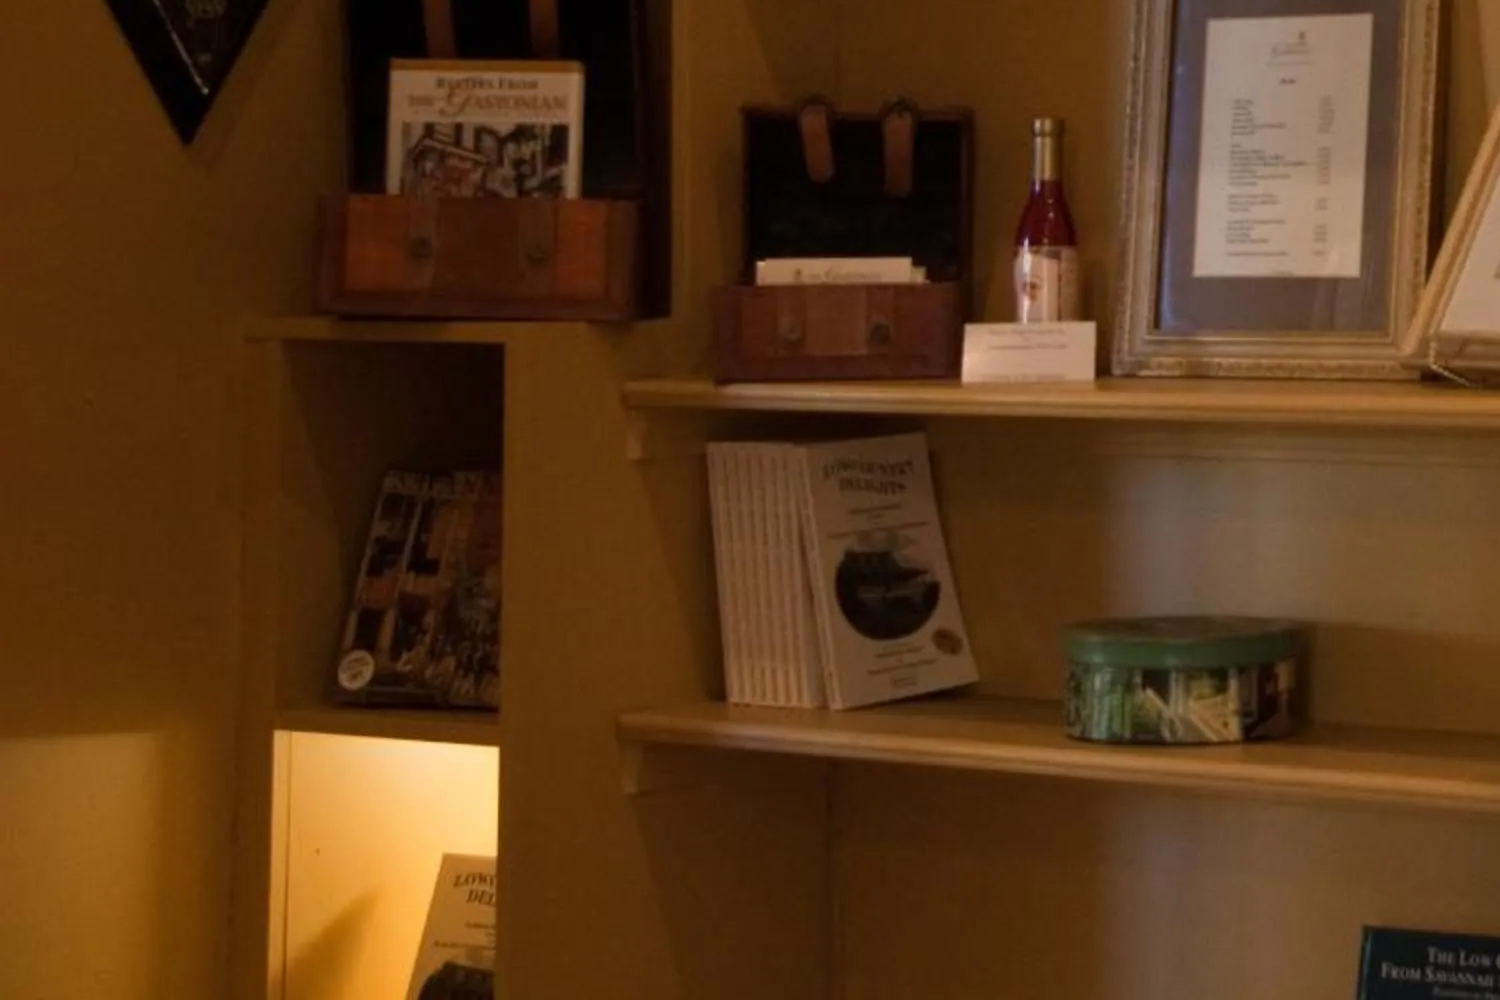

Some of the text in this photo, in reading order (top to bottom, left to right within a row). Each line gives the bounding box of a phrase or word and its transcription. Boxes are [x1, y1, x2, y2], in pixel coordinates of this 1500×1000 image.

[1427, 945, 1456, 965] THE
[1459, 948, 1492, 968] LOW
[1381, 960, 1422, 981] FROM
[1425, 965, 1495, 989] SAVANNAH
